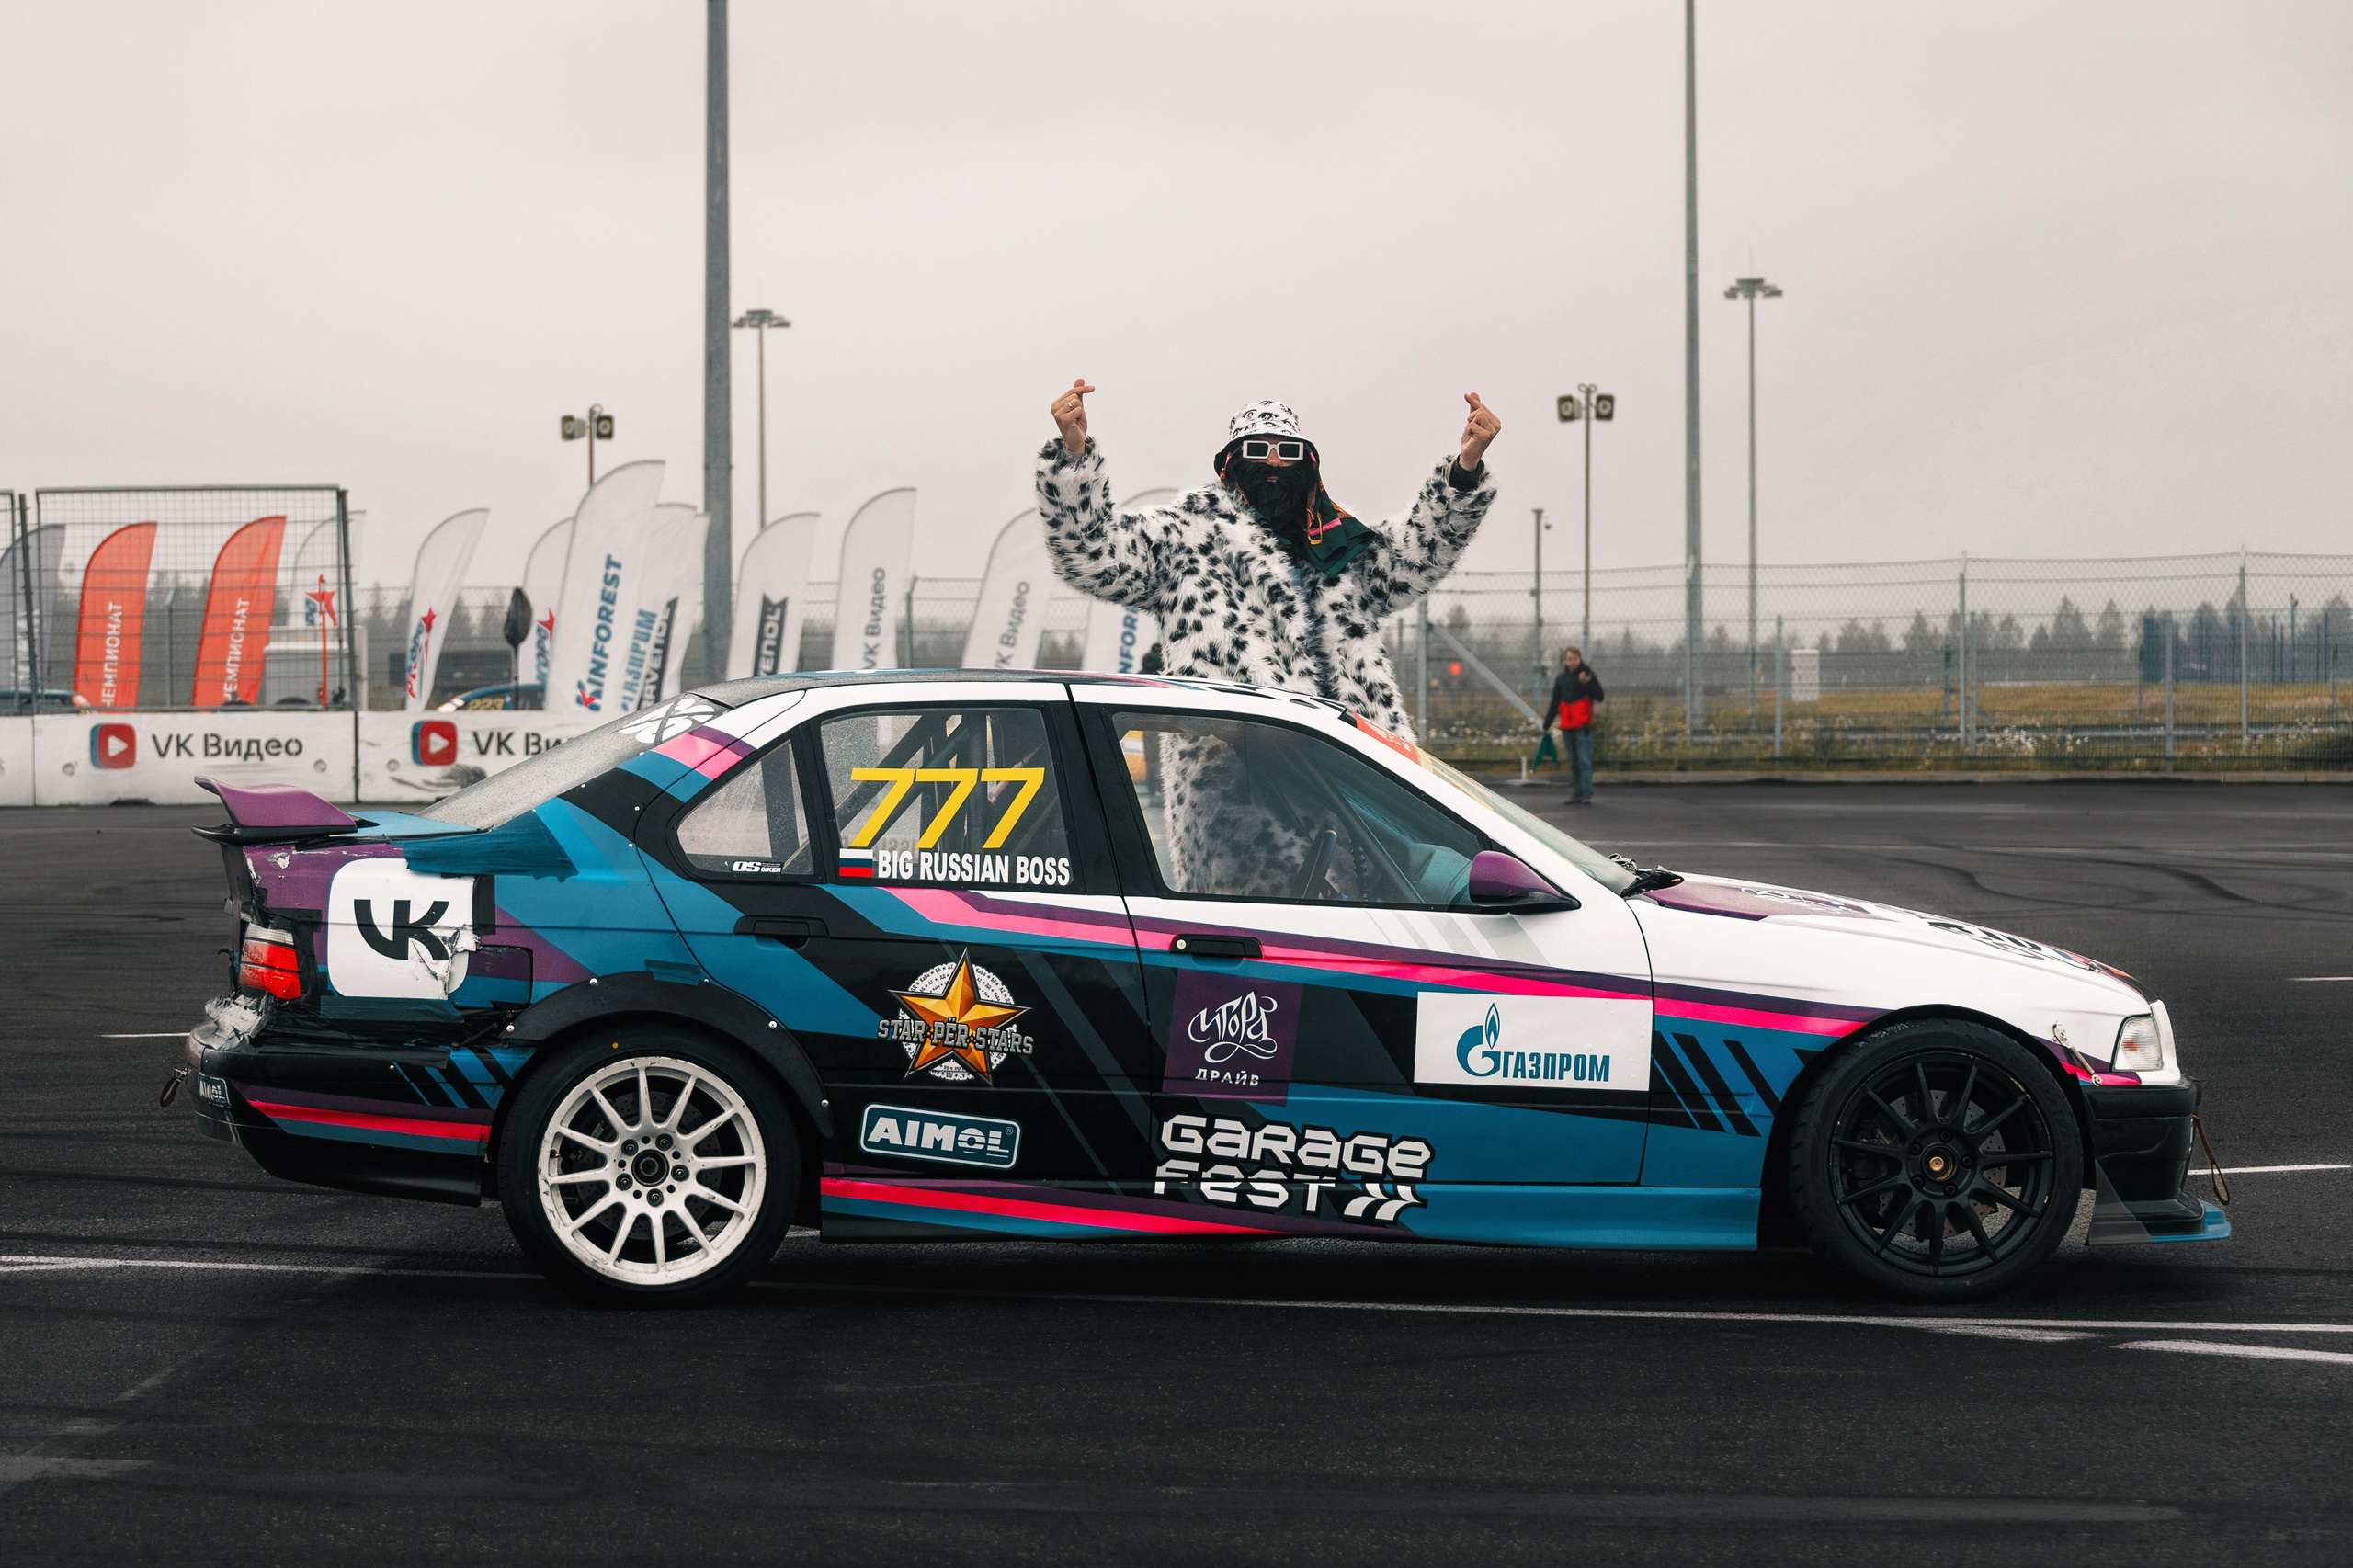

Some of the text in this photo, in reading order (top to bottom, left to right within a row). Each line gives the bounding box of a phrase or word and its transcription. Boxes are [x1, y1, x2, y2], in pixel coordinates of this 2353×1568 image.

[152, 733, 303, 761] VK Видео
[472, 731, 514, 756] VK
[849, 767, 1045, 848] 777
[878, 850, 1071, 886] BIG RUSSIAN BOSS
[877, 1017, 1034, 1054] STAR PËR STARS
[1195, 1068, 1260, 1086] ДРАЙВ
[1502, 1051, 1610, 1083] ГАЗПРОМ
